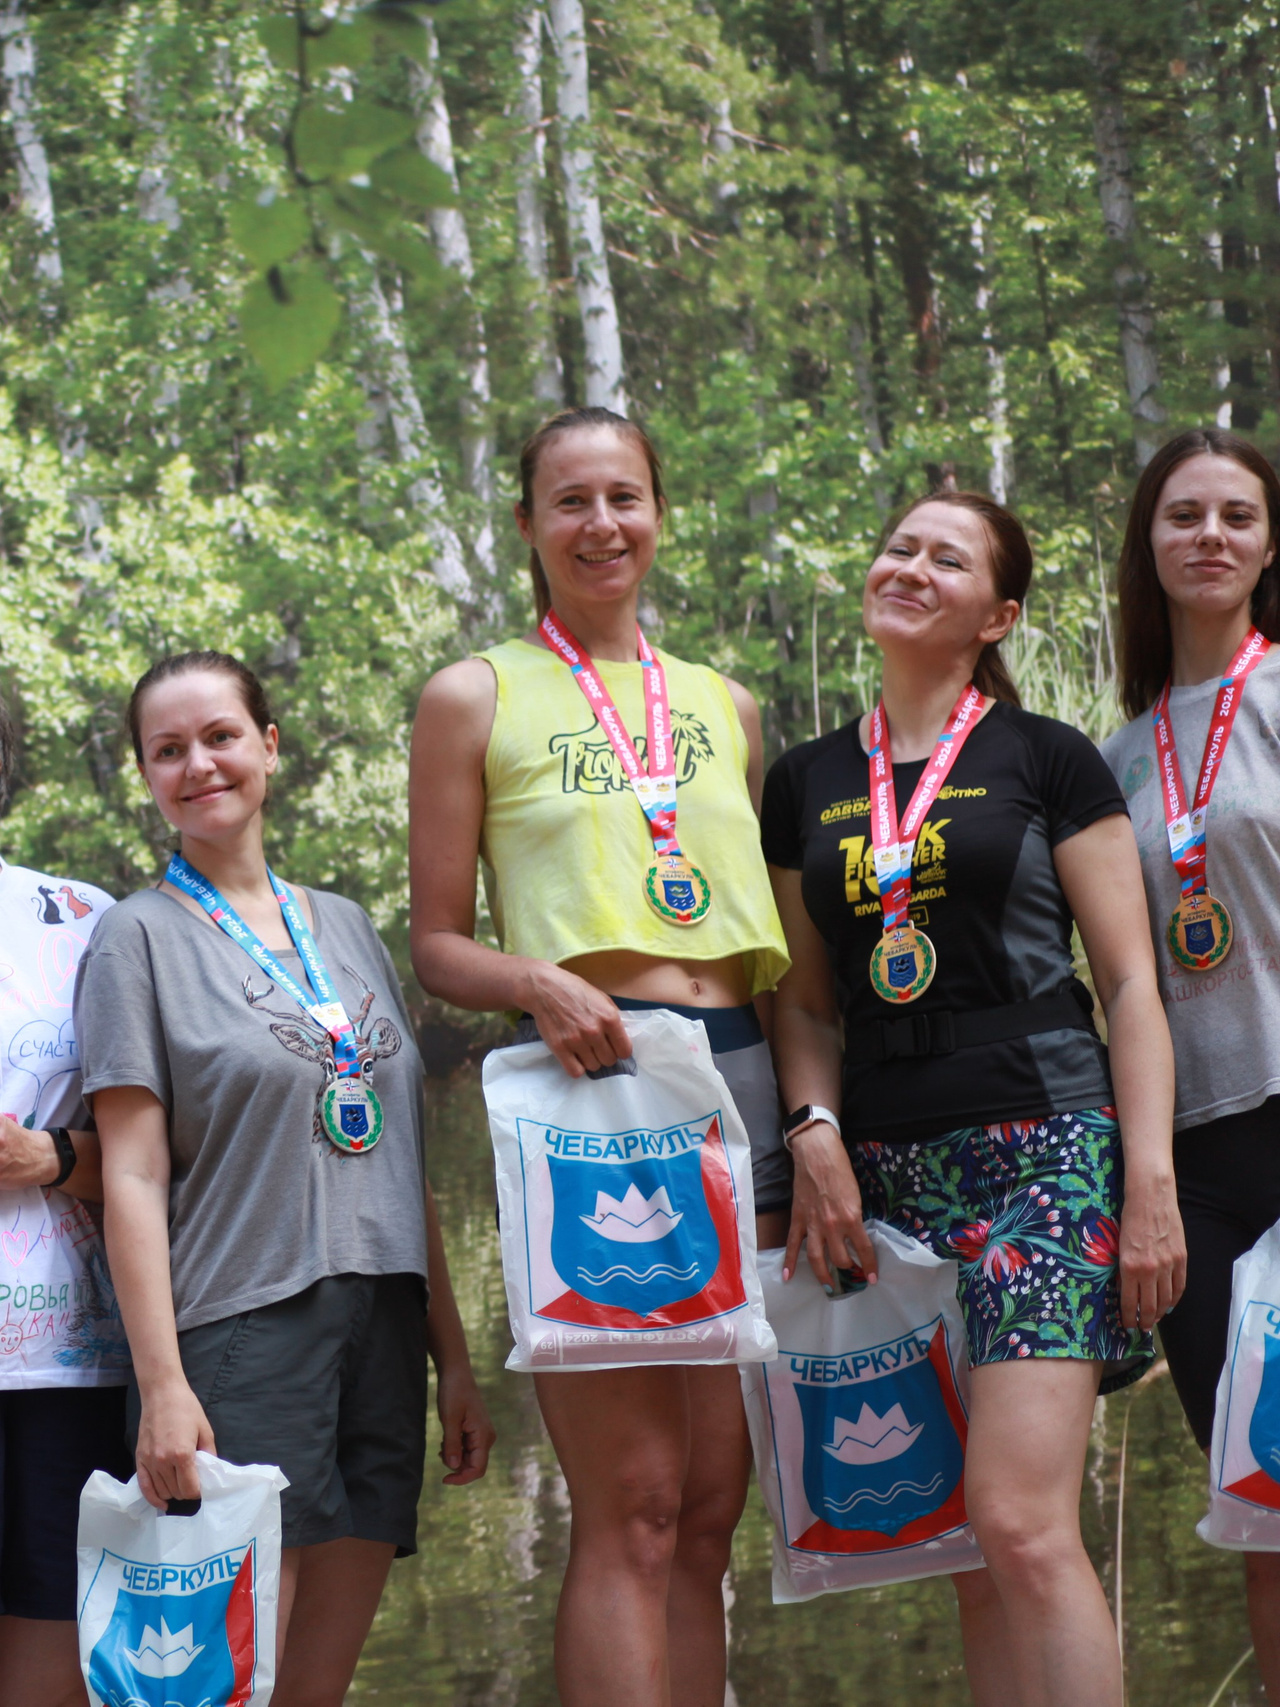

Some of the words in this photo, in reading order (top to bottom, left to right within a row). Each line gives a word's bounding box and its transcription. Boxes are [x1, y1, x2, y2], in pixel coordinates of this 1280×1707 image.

[582, 671, 603, 699] 2024
[601, 706, 638, 775] ЧЕБАРКУЛЬ
[652, 702, 667, 770] ЧЕБАРКУЛЬ
[1158, 718, 1169, 746] 2024
[1198, 725, 1224, 800] ЧЕБАРКУЛЬ
[1220, 687, 1235, 717] 2024
[876, 751, 886, 778] 2024
[1163, 751, 1180, 818] ЧЕБАРКУЛЬ
[877, 781, 891, 844] ЧЕБАРКУЛЬ
[903, 773, 939, 836] ЧЕБАРКУЛЬ
[935, 742, 954, 768] 2024
[222, 913, 249, 939] 2024
[286, 905, 303, 931] 2024
[854, 901, 882, 918] RIVA
[252, 944, 307, 1002] ЧЕБАРКУЛЬ
[300, 937, 330, 998] ЧЕБАРКУЛЬ
[1164, 955, 1280, 1004] АШКОРТОСТА
[544, 1125, 706, 1161] ЧЕБАРКУЛЬ
[790, 1336, 931, 1384] ЧЕБАРКУЛЬ
[122, 1554, 242, 1592] ЧЕБРКУЛЬ
